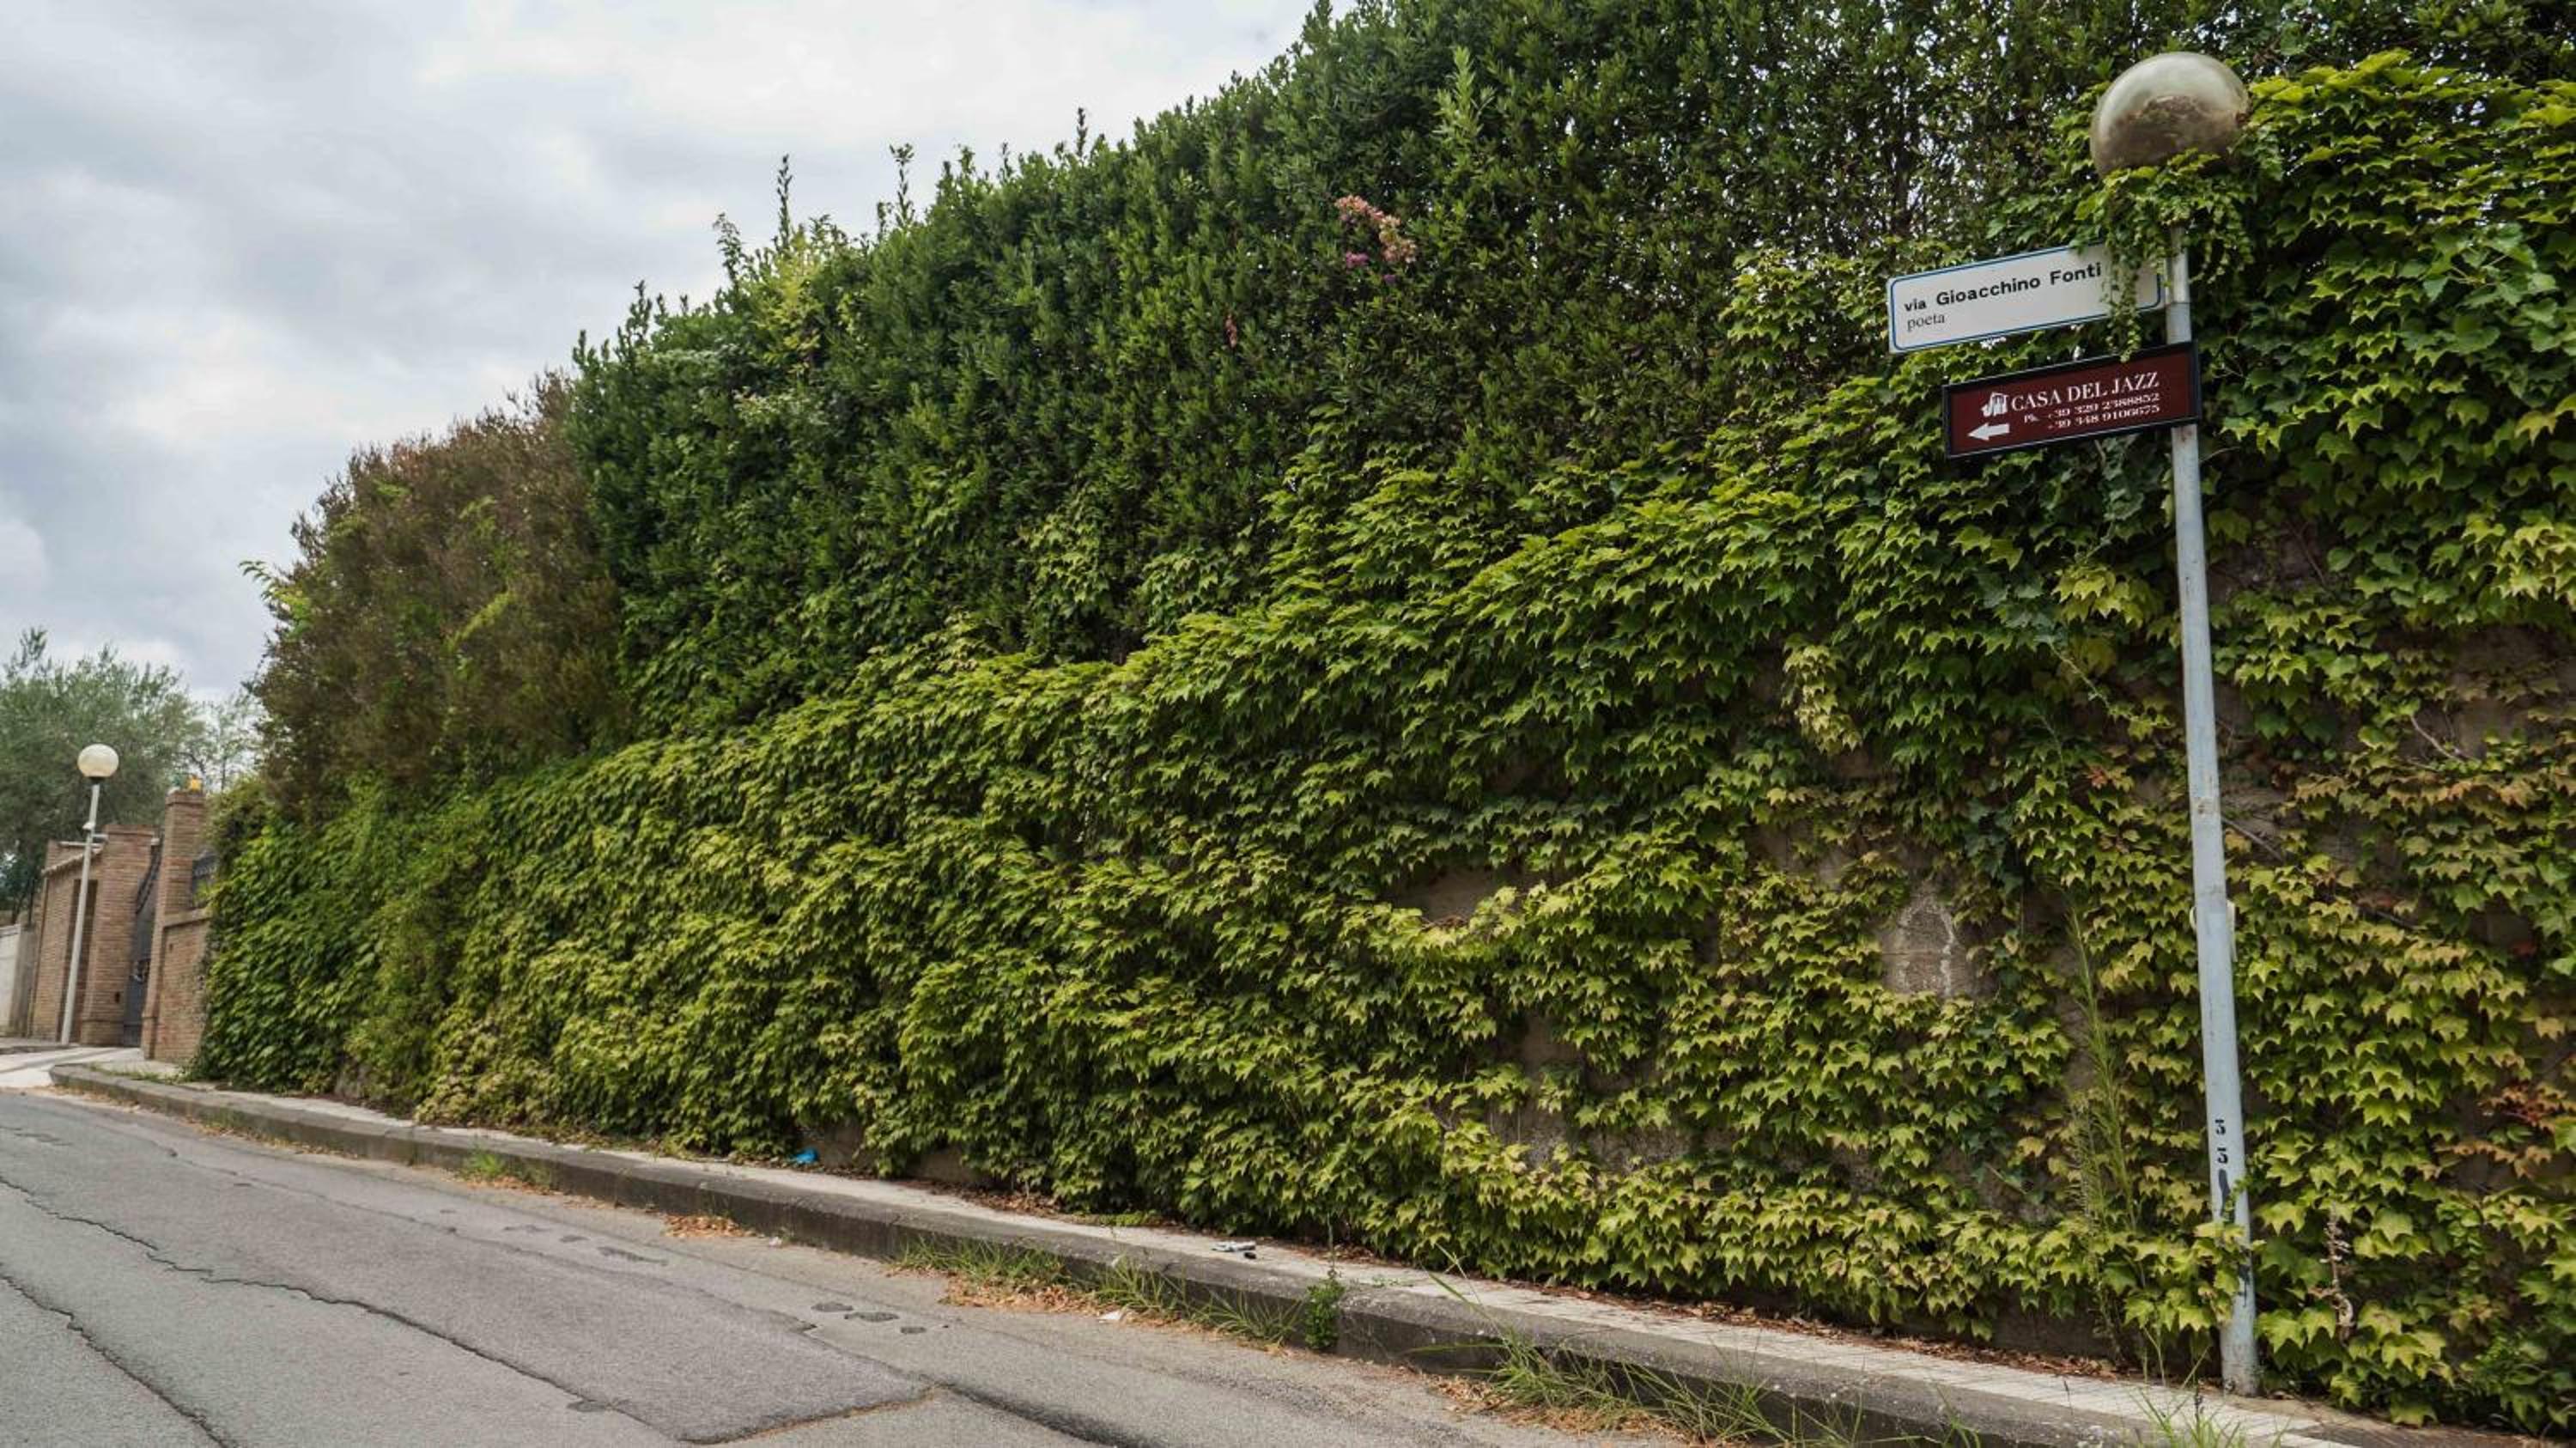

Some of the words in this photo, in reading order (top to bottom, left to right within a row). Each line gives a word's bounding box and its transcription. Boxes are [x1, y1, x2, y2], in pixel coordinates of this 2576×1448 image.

[1904, 297, 1927, 312] via
[1936, 276, 2041, 306] Gioacchino
[2050, 262, 2102, 285] Fonti
[1907, 313, 1946, 332] poeta
[2011, 389, 2062, 411] CASA
[2068, 381, 2108, 403] DEL
[2111, 371, 2160, 395] JAZZ
